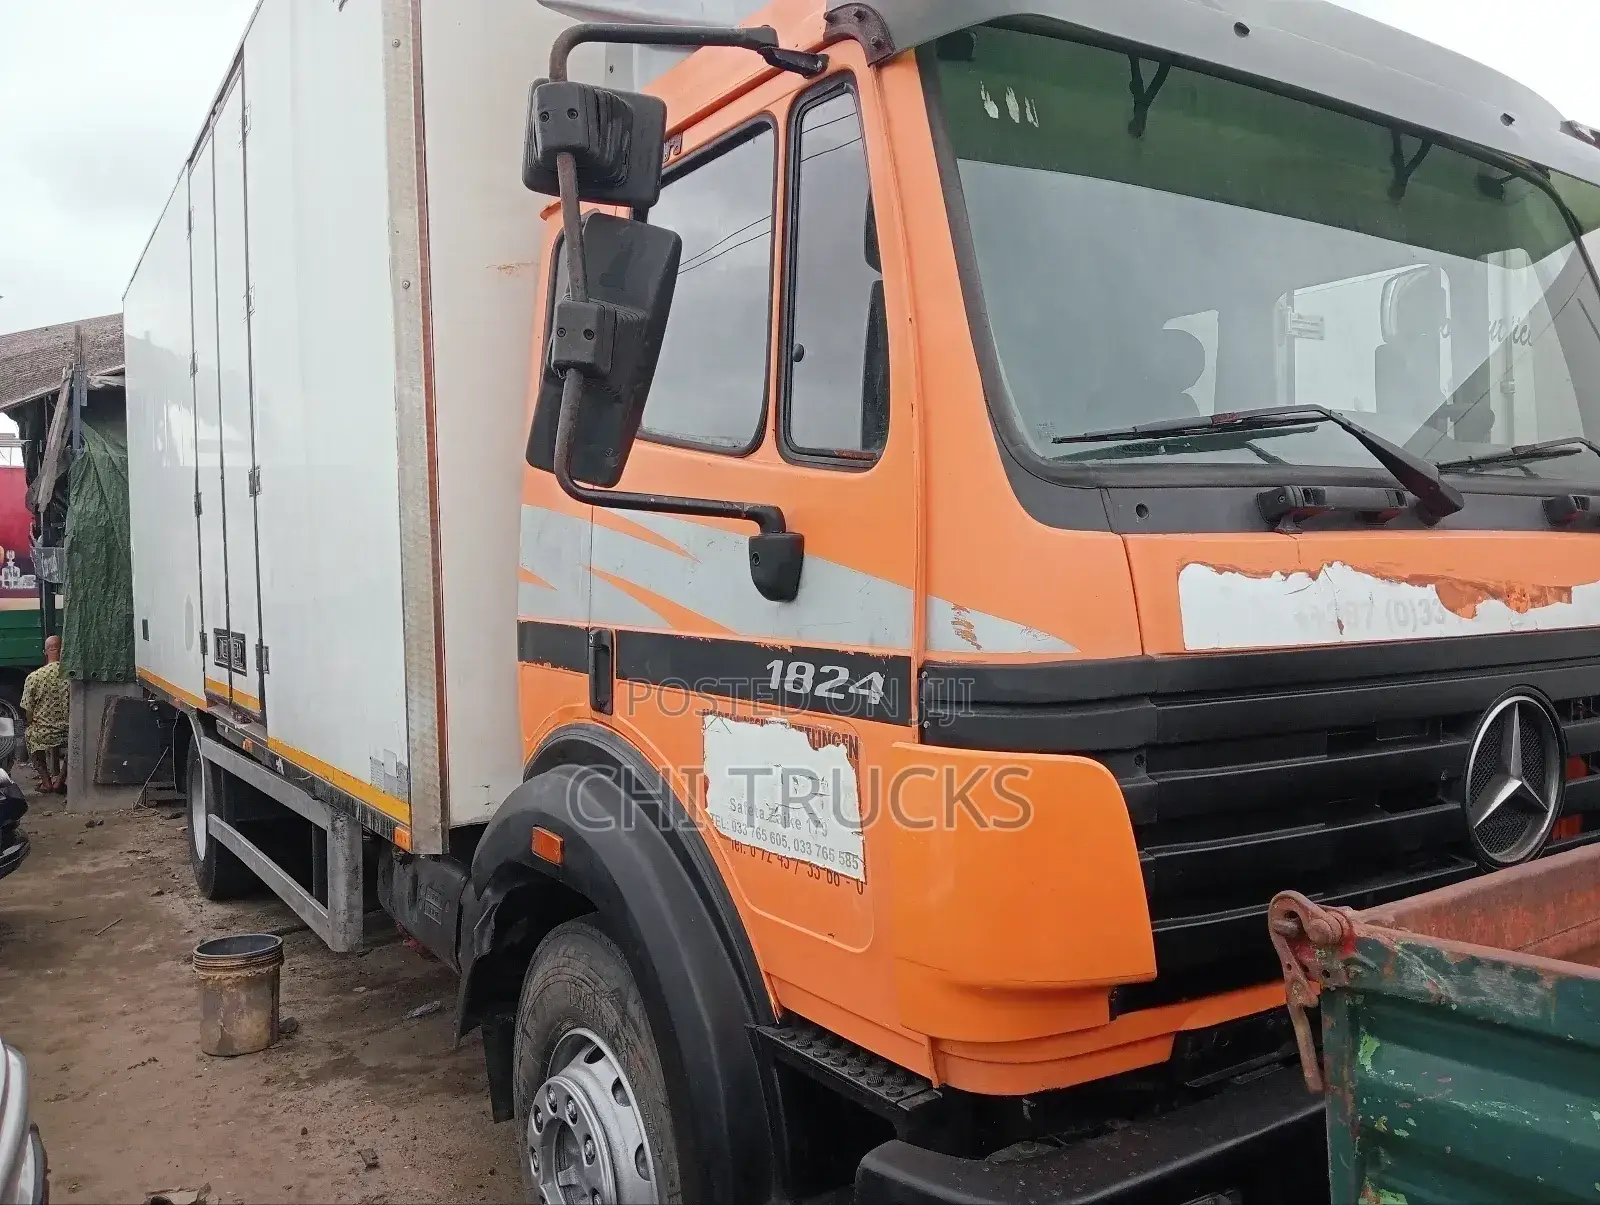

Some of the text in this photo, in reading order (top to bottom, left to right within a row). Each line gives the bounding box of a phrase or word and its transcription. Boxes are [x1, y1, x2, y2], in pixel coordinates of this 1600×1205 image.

[766, 659, 886, 705] 1824
[732, 820, 748, 836] 033
[751, 826, 768, 842] 765
[793, 838, 813, 856] 033
[815, 843, 836, 863] 765
[838, 850, 860, 870] 585
